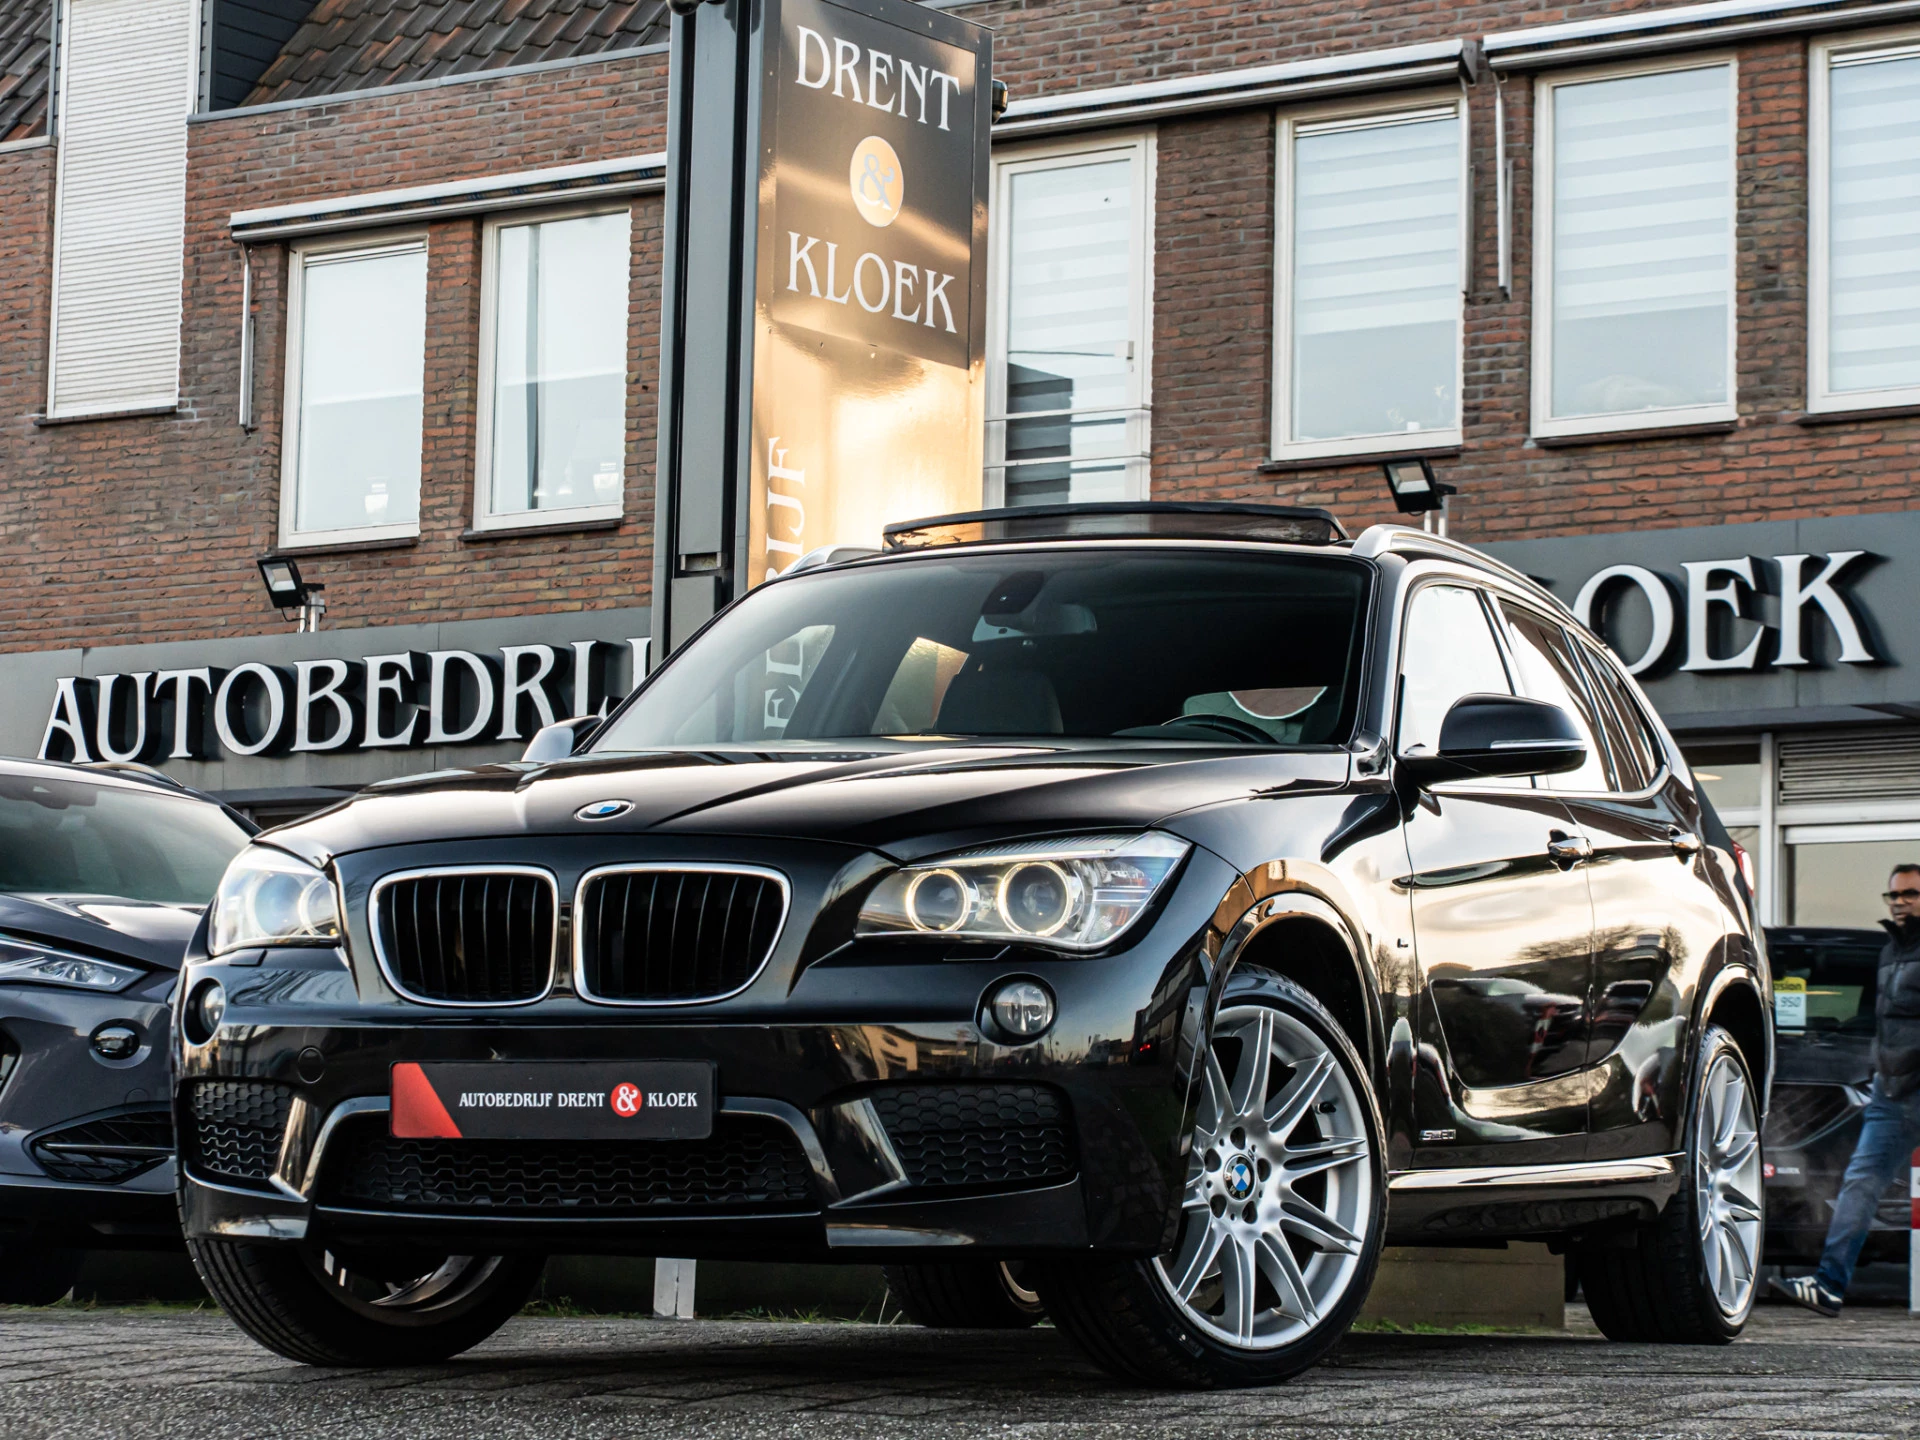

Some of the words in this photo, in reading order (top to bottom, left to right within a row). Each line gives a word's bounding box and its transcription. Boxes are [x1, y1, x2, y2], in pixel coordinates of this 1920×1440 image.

[795, 25, 961, 132] DRENT
[858, 153, 895, 210] &
[787, 231, 958, 334] KLOEK
[459, 1092, 553, 1107] AUTOBEDRIJF
[557, 1092, 605, 1107] DRENT
[616, 1086, 638, 1111] &
[647, 1092, 698, 1107] KLOEK
